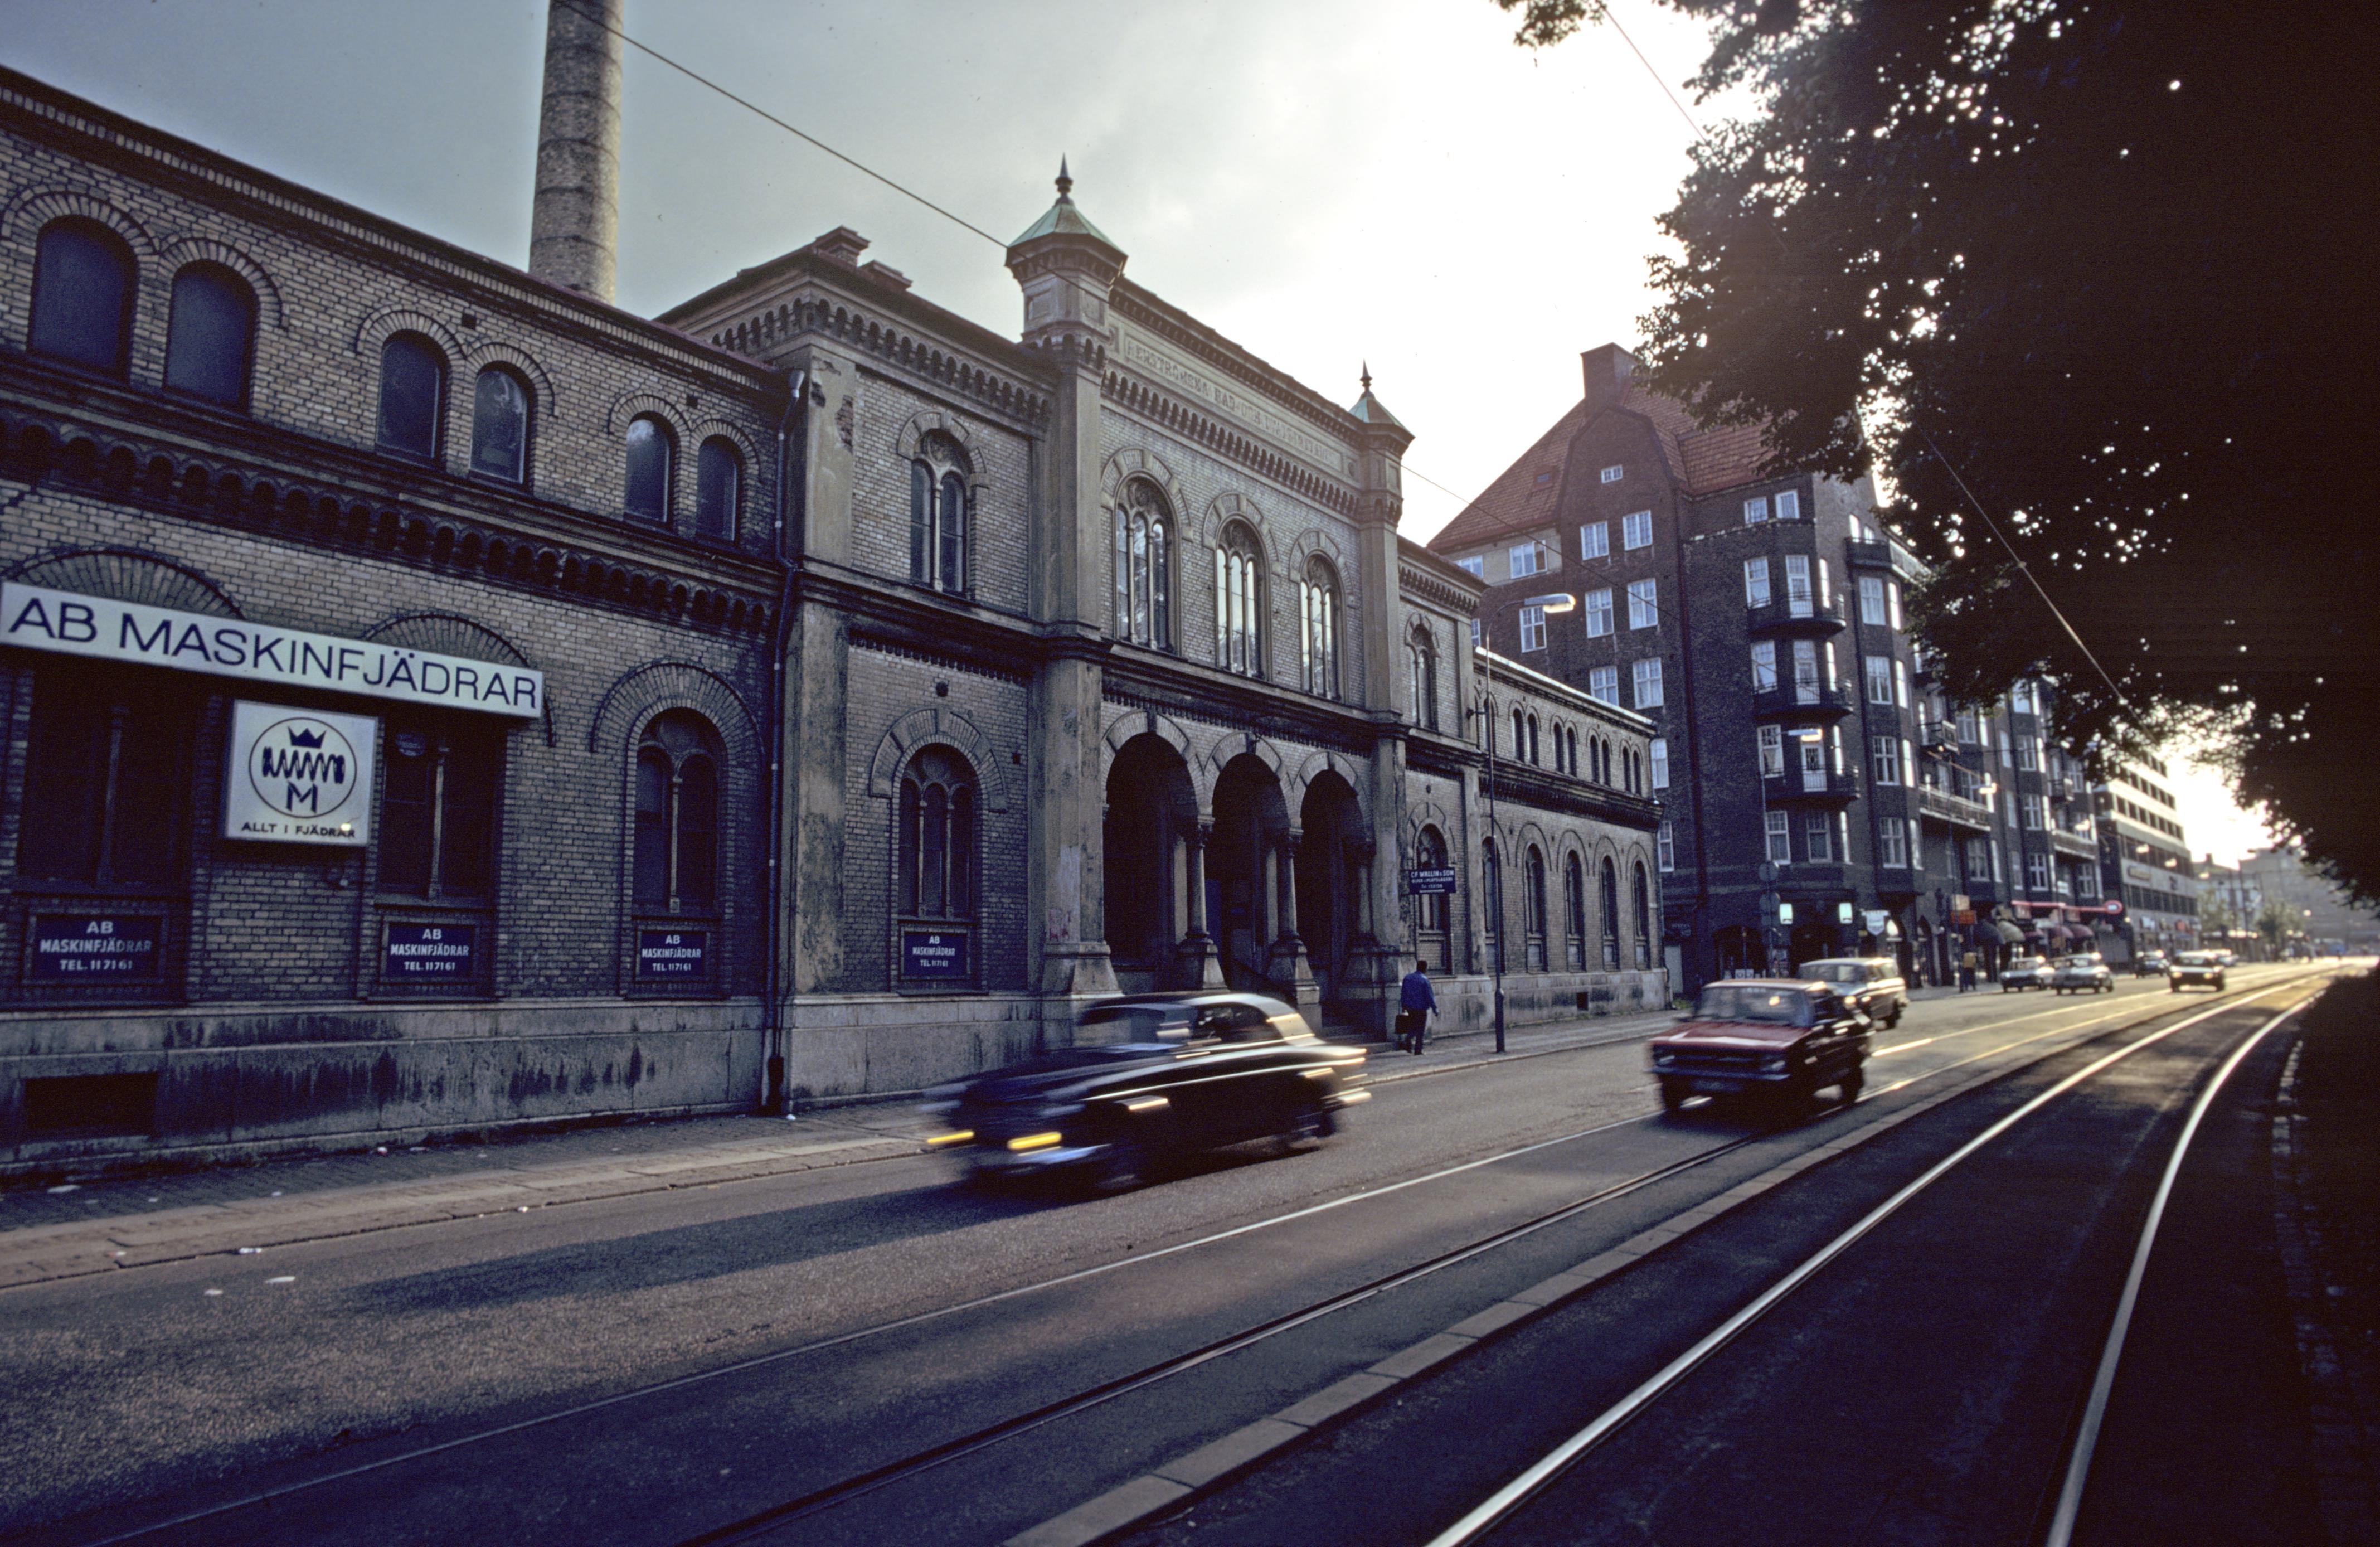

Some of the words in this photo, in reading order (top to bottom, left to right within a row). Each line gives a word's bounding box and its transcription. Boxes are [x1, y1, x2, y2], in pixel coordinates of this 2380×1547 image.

[8, 597, 98, 643] AB
[119, 612, 537, 709] MASKINFJÄDRAR
[241, 822, 277, 833] ALLT
[284, 825, 288, 834] I
[295, 825, 356, 838] FJÄDRAR
[86, 921, 114, 934] AB
[422, 928, 442, 940] AB
[666, 935, 681, 944] AB
[929, 935, 940, 944] AB
[40, 937, 152, 953] MASKINFJÄDRAR
[391, 943, 469, 956] MASKINFJÄDRAR
[912, 946, 955, 956] MASKINFJÄDRAR
[642, 947, 702, 958] MASKINFJÄDRAR
